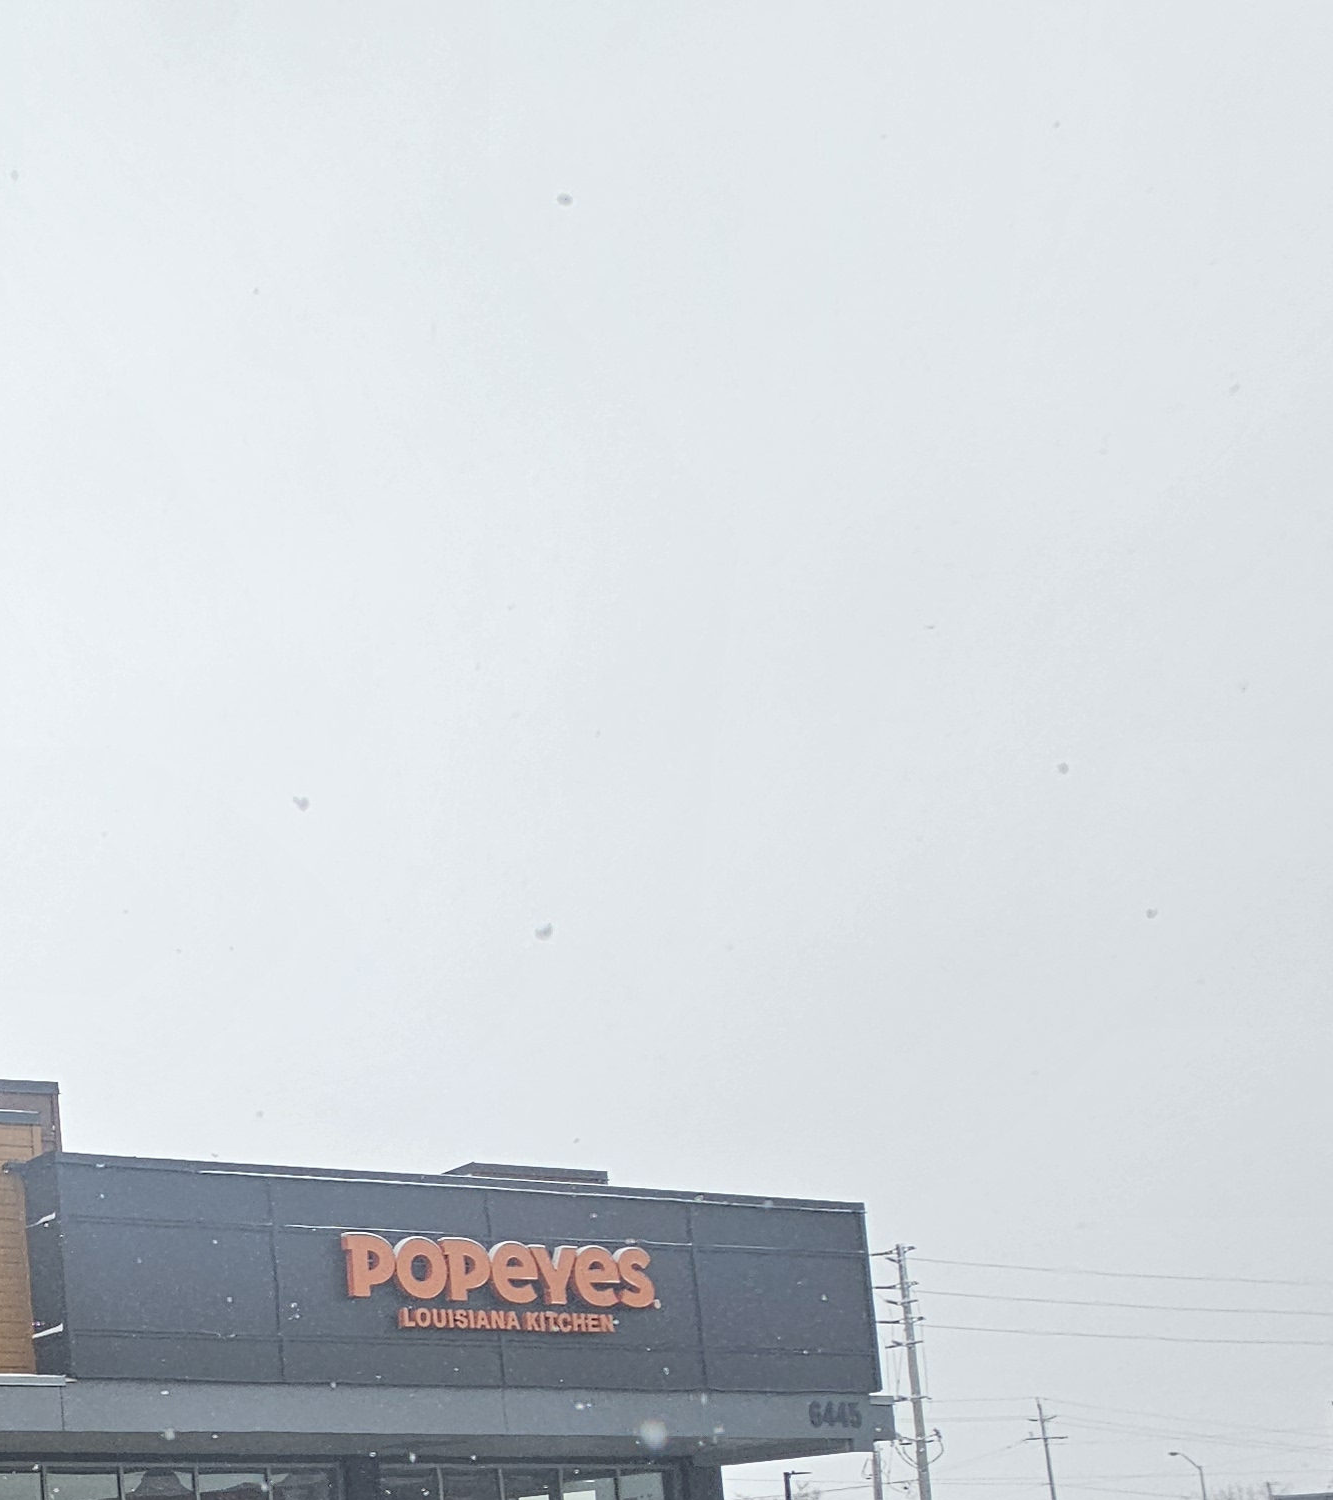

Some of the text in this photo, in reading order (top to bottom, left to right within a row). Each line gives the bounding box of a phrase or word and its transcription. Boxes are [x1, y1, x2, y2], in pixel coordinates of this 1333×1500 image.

[399, 1307, 615, 1333] LOUISIANA KITCHEN
[809, 1401, 863, 1429] 6445
